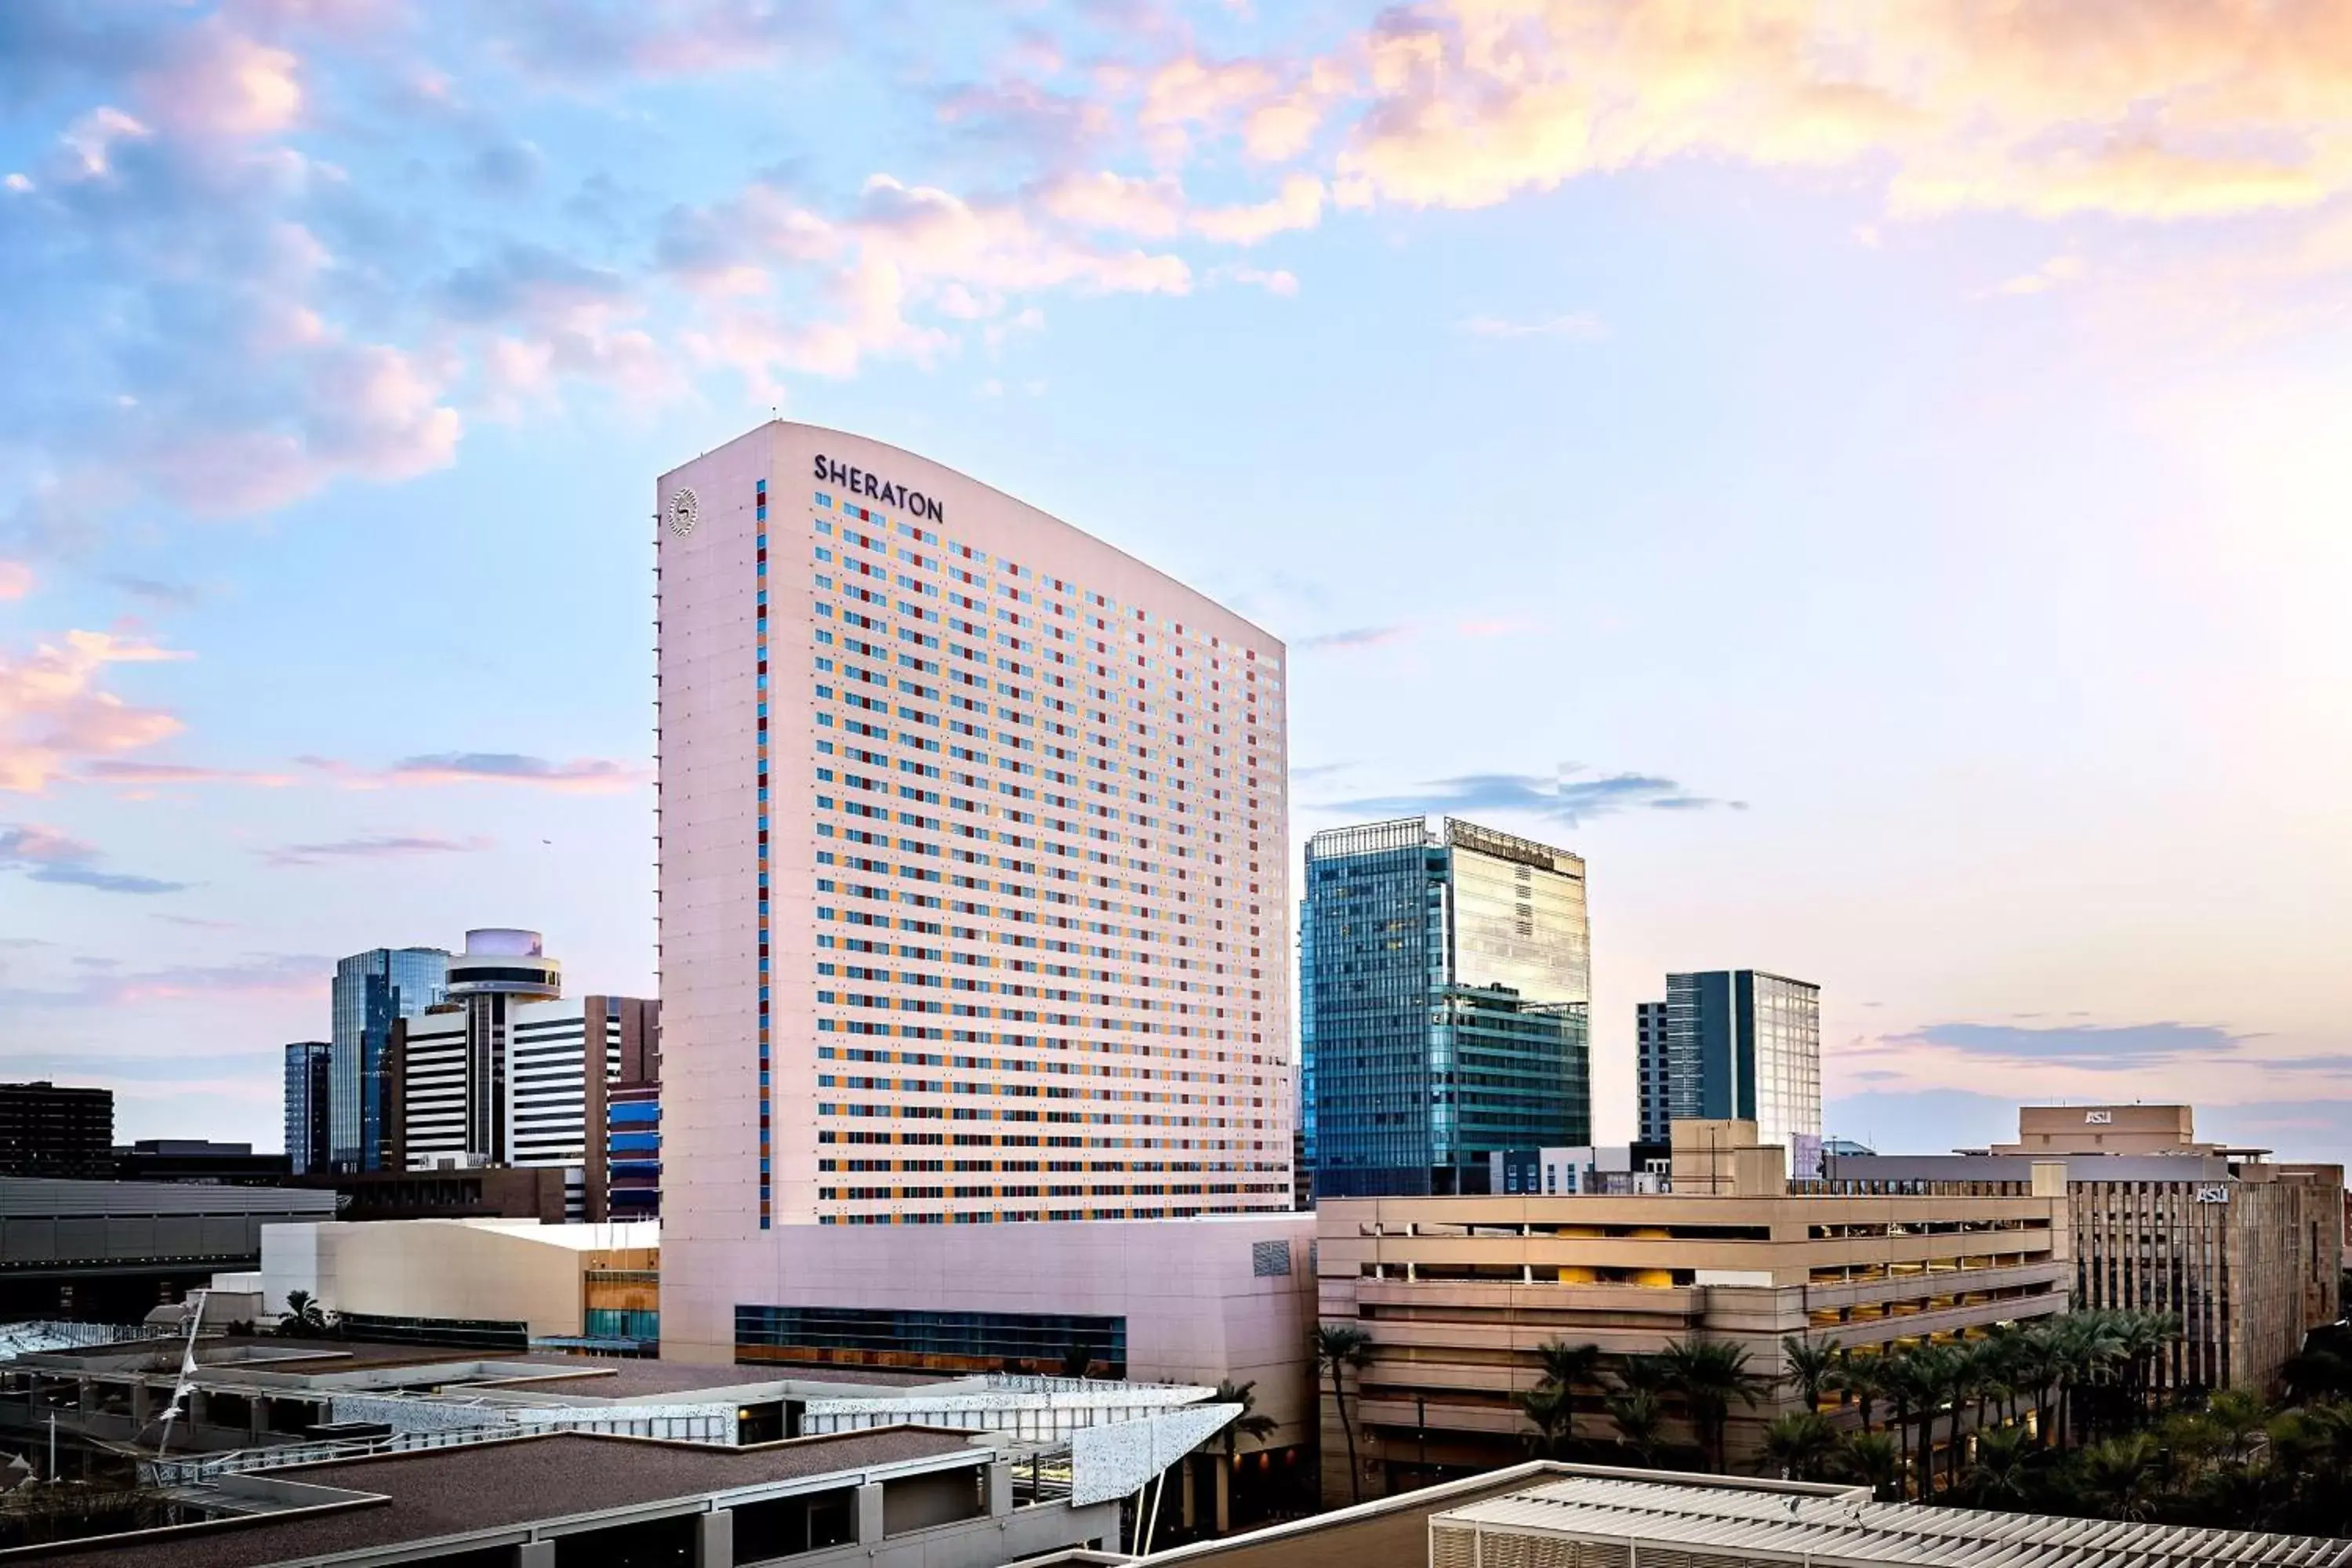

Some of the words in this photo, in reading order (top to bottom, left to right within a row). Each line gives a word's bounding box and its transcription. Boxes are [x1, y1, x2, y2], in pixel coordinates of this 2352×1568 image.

[815, 454, 943, 524] SHERATON
[2085, 1111, 2111, 1123] ASU
[2196, 1188, 2229, 1203] ASU
